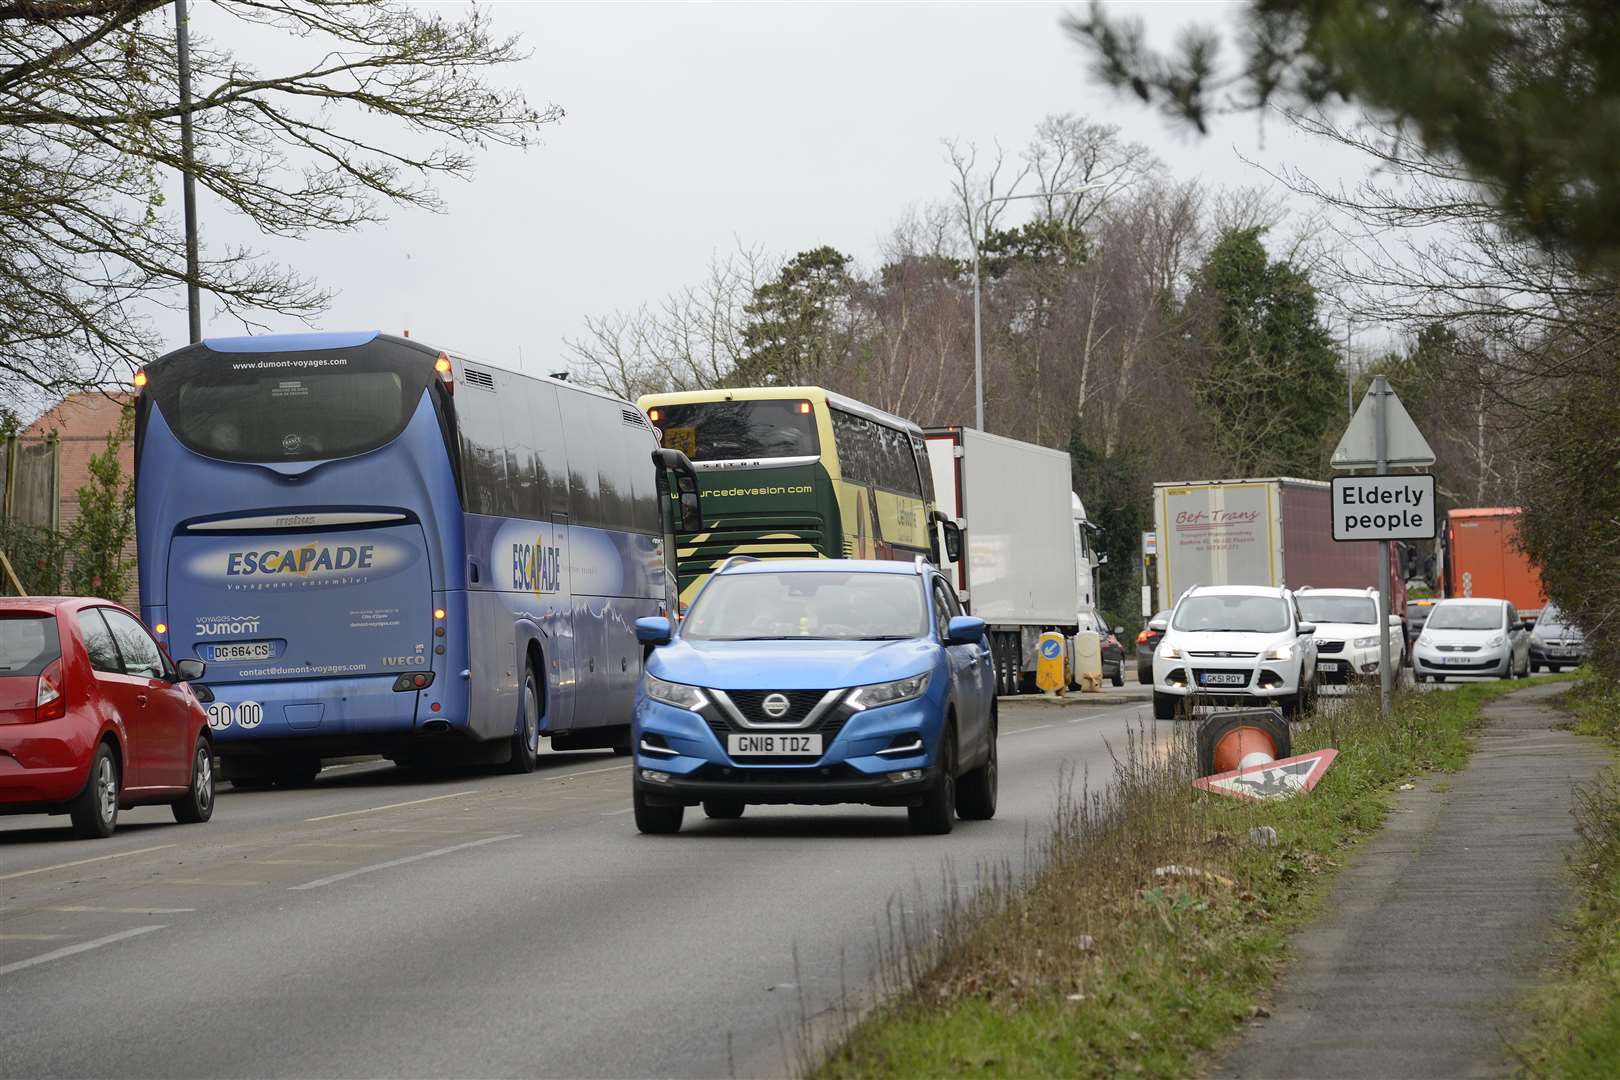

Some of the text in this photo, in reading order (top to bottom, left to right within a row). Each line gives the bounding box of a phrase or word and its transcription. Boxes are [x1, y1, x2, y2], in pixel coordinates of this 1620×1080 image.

[233, 359, 347, 369] www.dumont-voyages.com
[1343, 485, 1424, 507] Elderly
[1345, 509, 1423, 532] people
[226, 545, 375, 576] ESCAPADE
[512, 543, 560, 592] ESCAPADE
[239, 663, 367, 677] contact@dumont-voyages.com
[382, 655, 425, 666] IVECO
[208, 704, 260, 727] 90 100
[738, 737, 811, 752] GN18 TDZ
